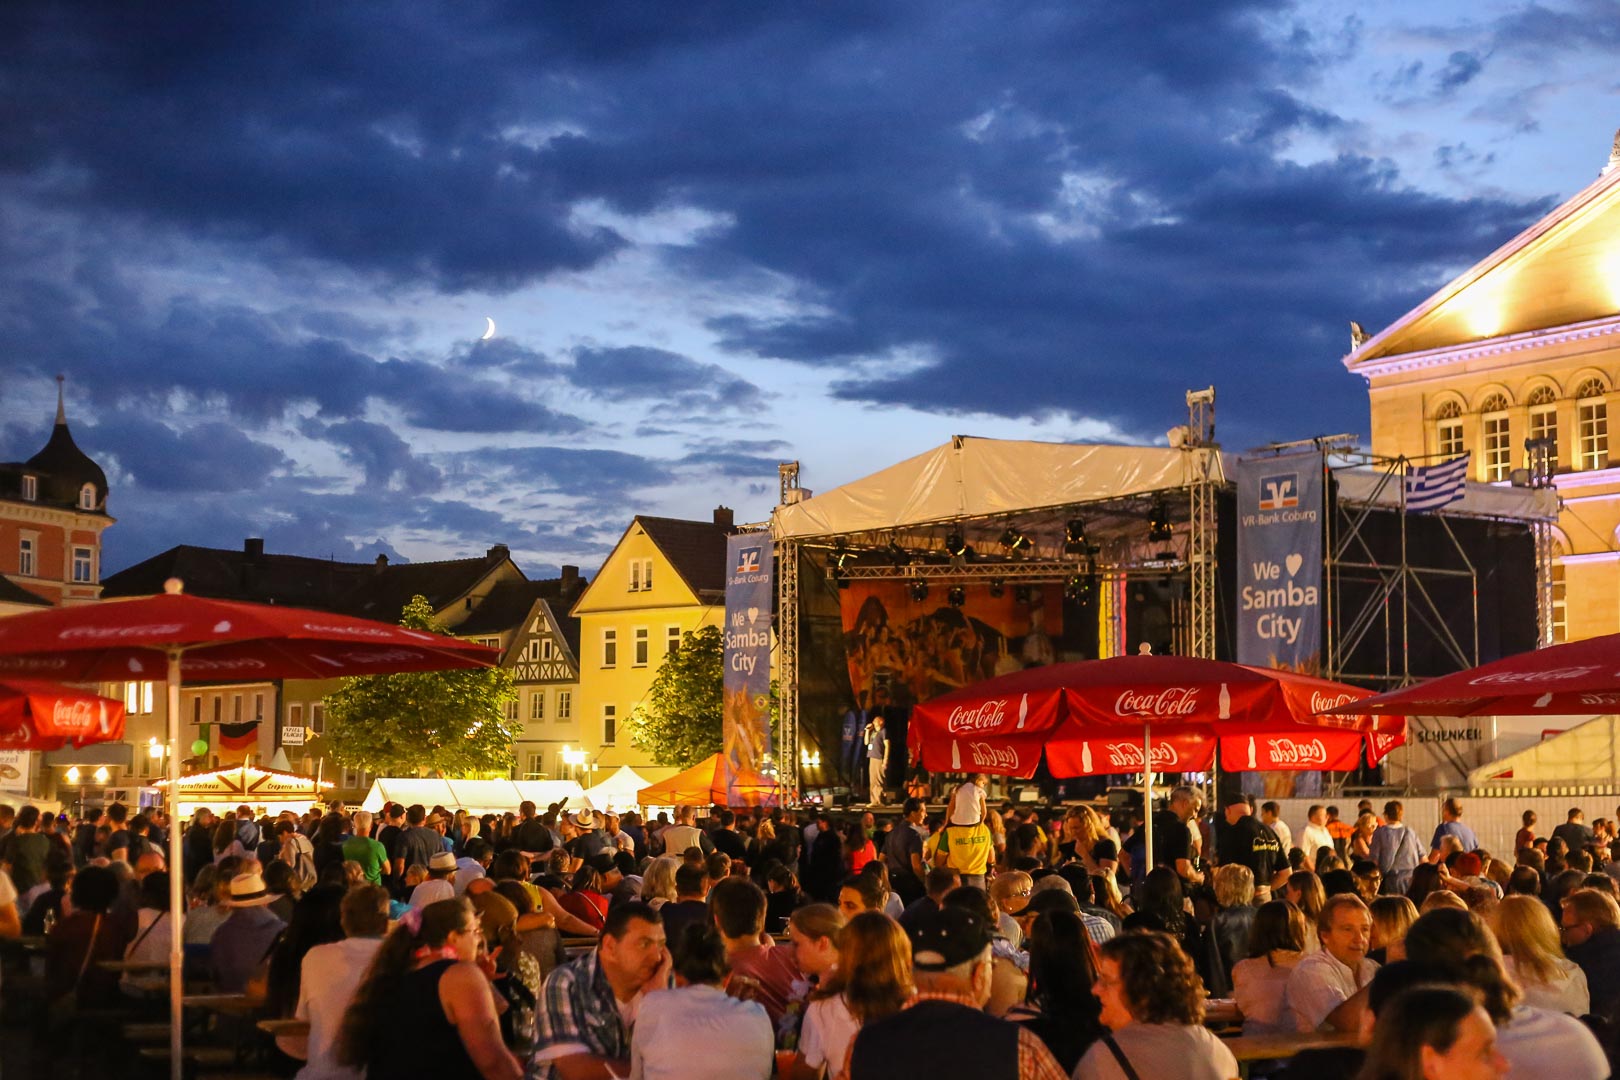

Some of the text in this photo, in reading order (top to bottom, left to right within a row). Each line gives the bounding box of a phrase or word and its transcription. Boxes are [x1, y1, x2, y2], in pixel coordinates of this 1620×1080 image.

[1242, 509, 1317, 528] VR-Bank Coburg
[1253, 561, 1281, 581] We
[1242, 580, 1319, 612] Samba
[731, 612, 745, 628] We
[1256, 612, 1302, 645] City
[725, 628, 769, 650] Samba
[731, 653, 757, 677] City
[1114, 687, 1201, 717] Coca-Cola
[948, 699, 1009, 733] Coca-Cola
